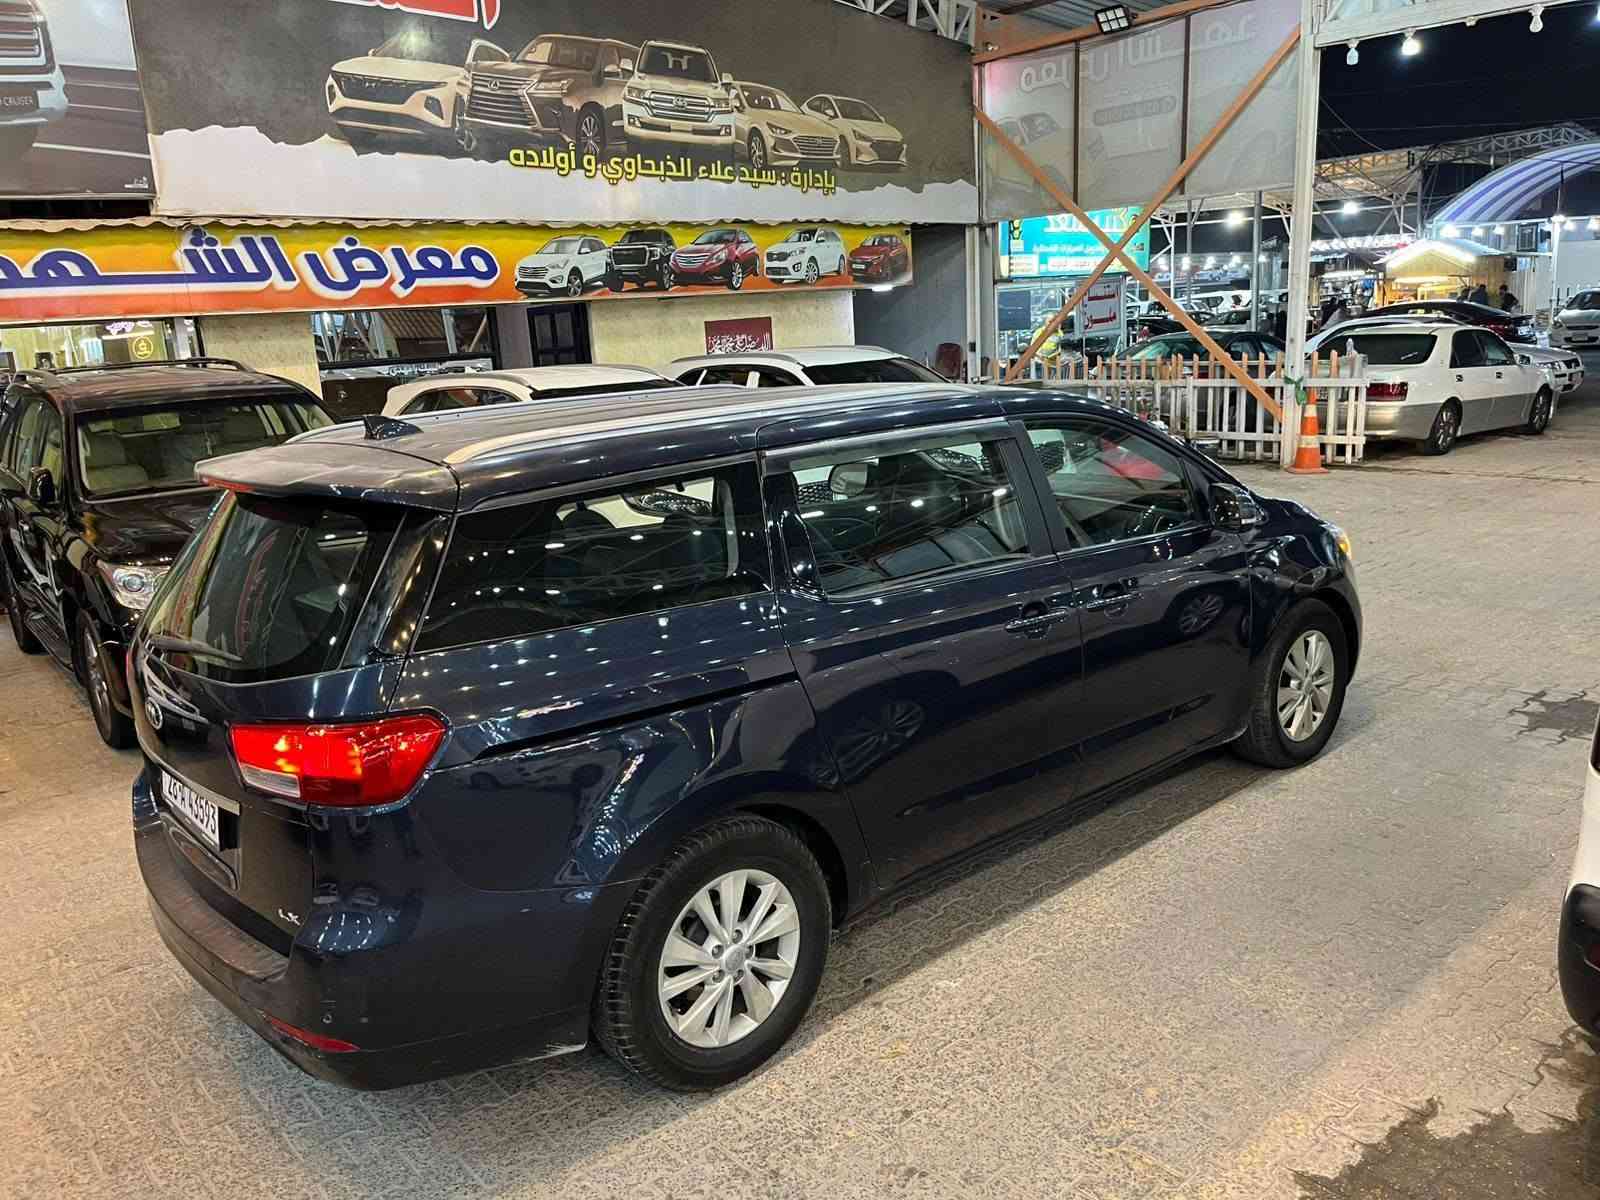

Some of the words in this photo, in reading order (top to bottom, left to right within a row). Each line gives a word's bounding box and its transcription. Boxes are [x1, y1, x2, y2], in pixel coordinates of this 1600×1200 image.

[508, 141, 577, 176] أولاده
[698, 159, 736, 182] علاء
[738, 165, 777, 189] سيد
[301, 235, 499, 296] معرض
[278, 907, 301, 926] LX
